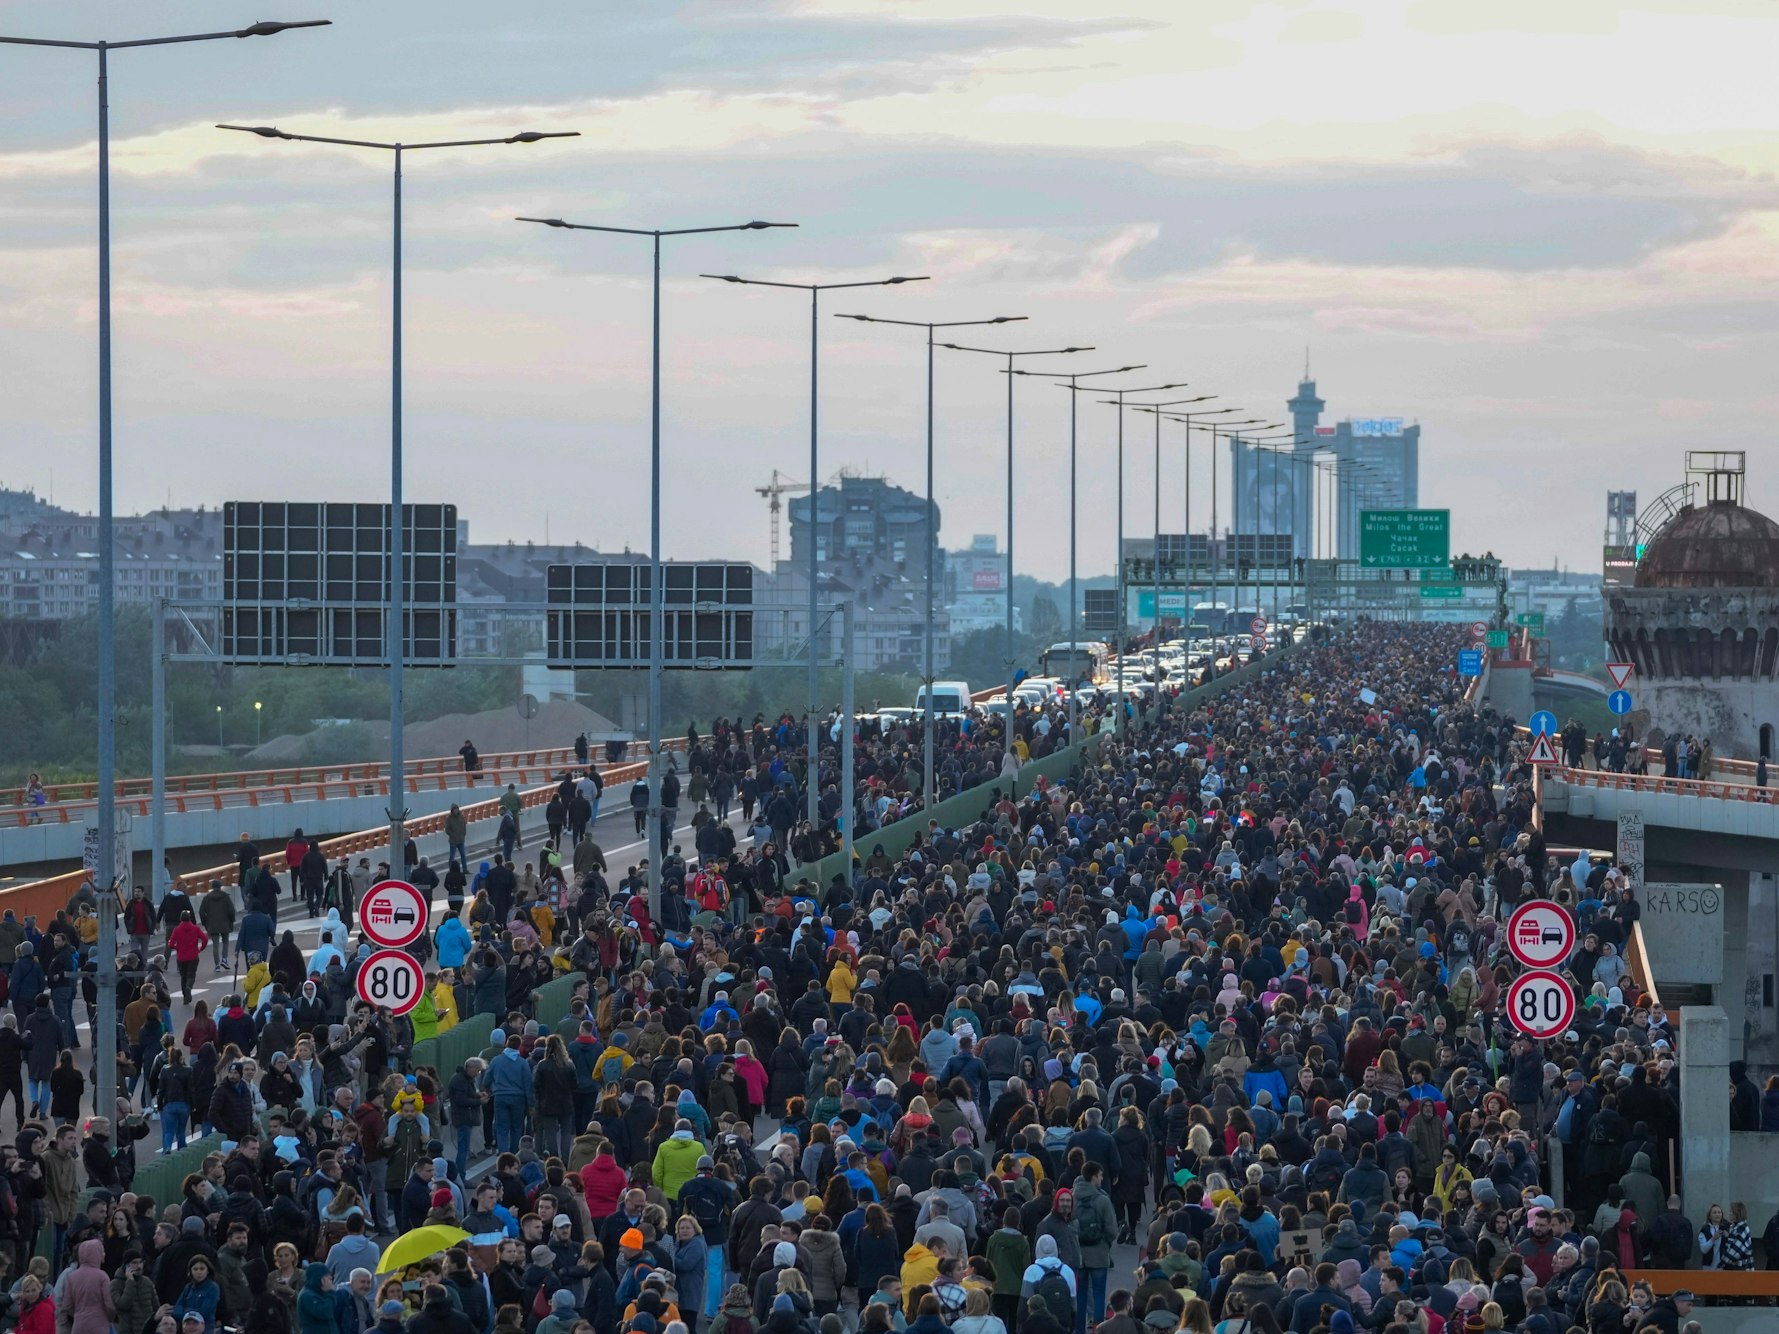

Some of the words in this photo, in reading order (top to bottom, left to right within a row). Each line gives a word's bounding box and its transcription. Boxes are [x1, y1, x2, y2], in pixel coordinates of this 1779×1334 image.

[1369, 514, 1400, 522] Милош
[1407, 514, 1440, 522] Велики
[1397, 523, 1412, 531] the
[1419, 523, 1443, 531] Great
[1390, 534, 1418, 542] Чачак
[372, 967, 410, 1000] 80
[1521, 988, 1560, 1021] 80
